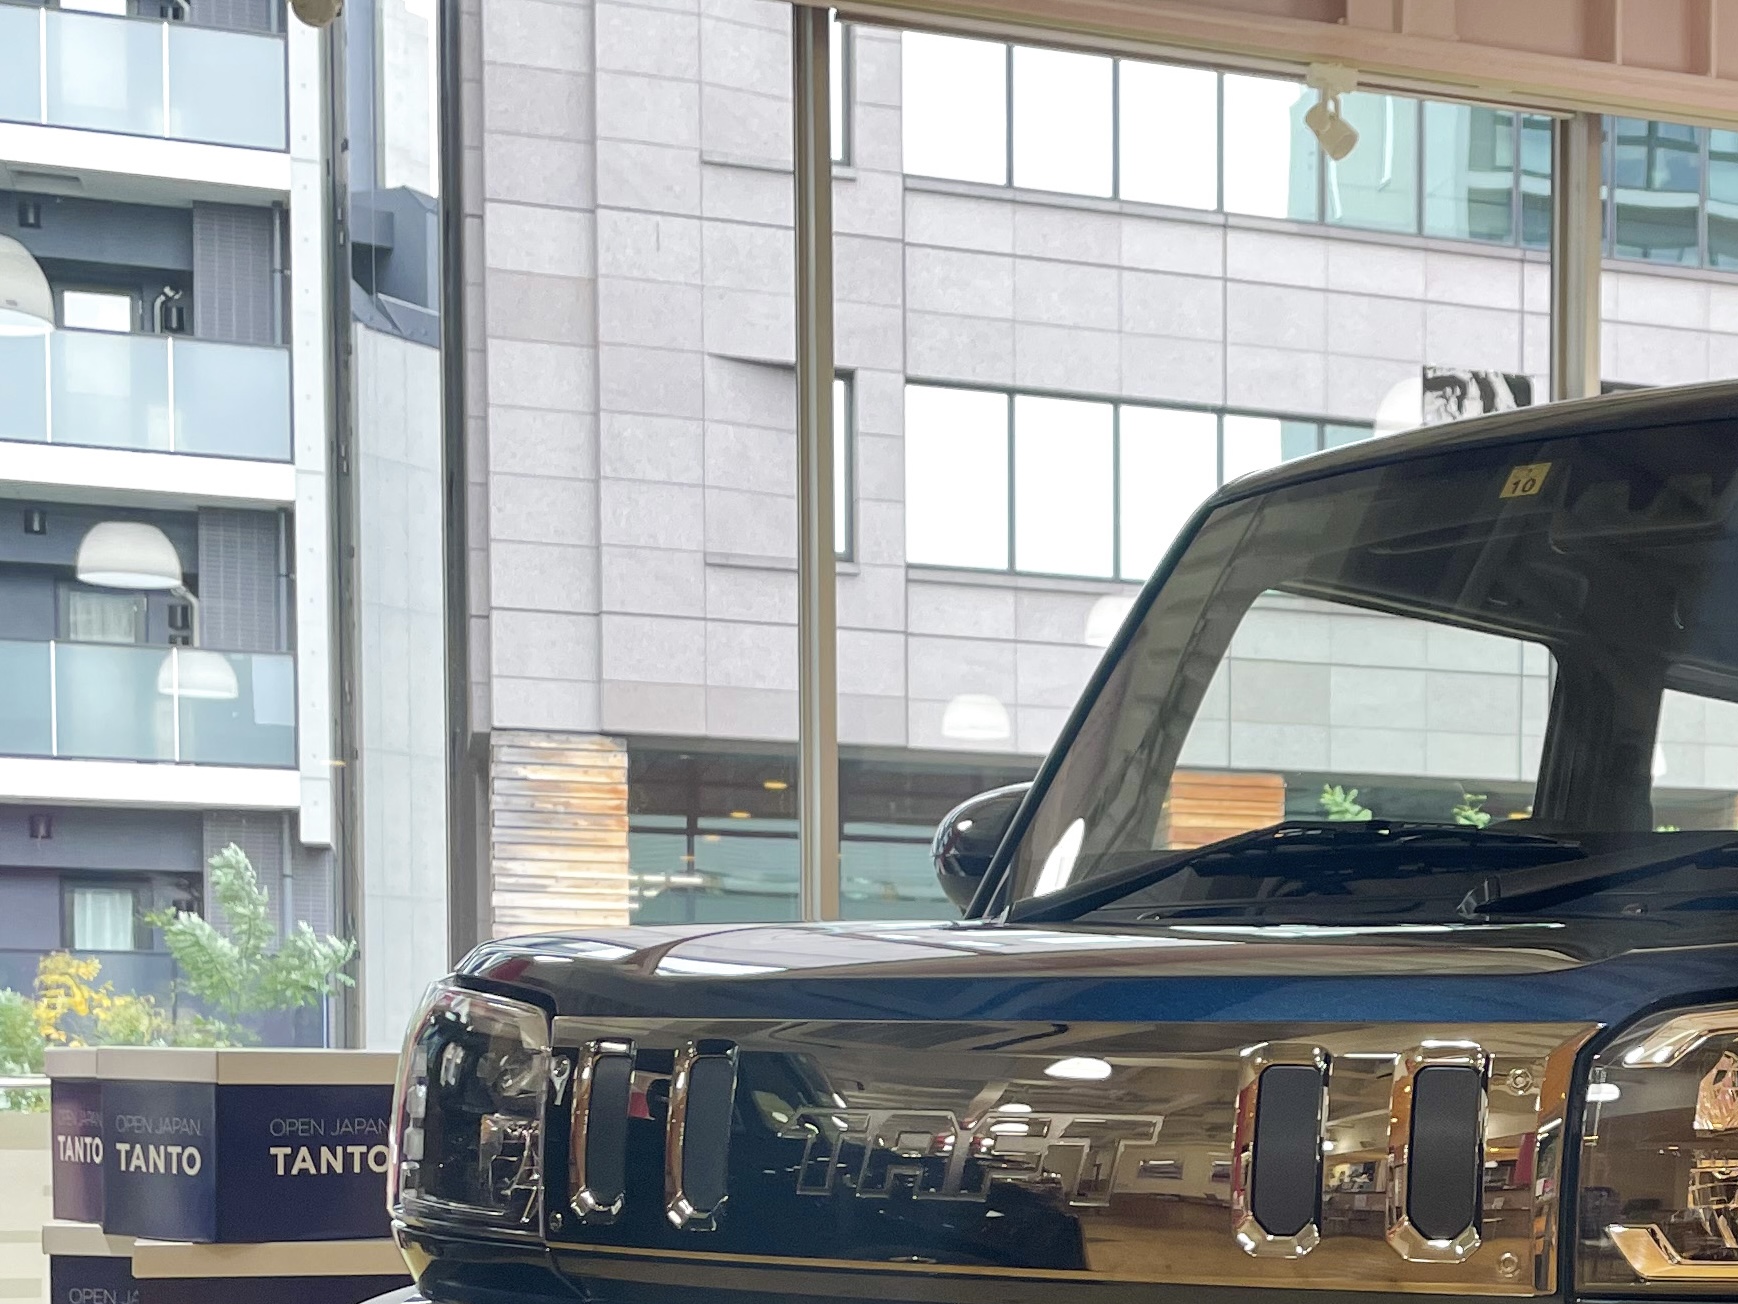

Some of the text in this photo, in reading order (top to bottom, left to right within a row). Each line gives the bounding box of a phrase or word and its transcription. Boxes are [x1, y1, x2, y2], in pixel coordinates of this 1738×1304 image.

[1512, 478, 1537, 495] 10
[115, 1114, 151, 1134] OPEN
[269, 1118, 325, 1137] OPEN
[57, 1135, 103, 1165] TANTO
[115, 1142, 202, 1176] TANTO
[269, 1144, 390, 1176] TANTO
[778, 1108, 1164, 1207] TAFT
